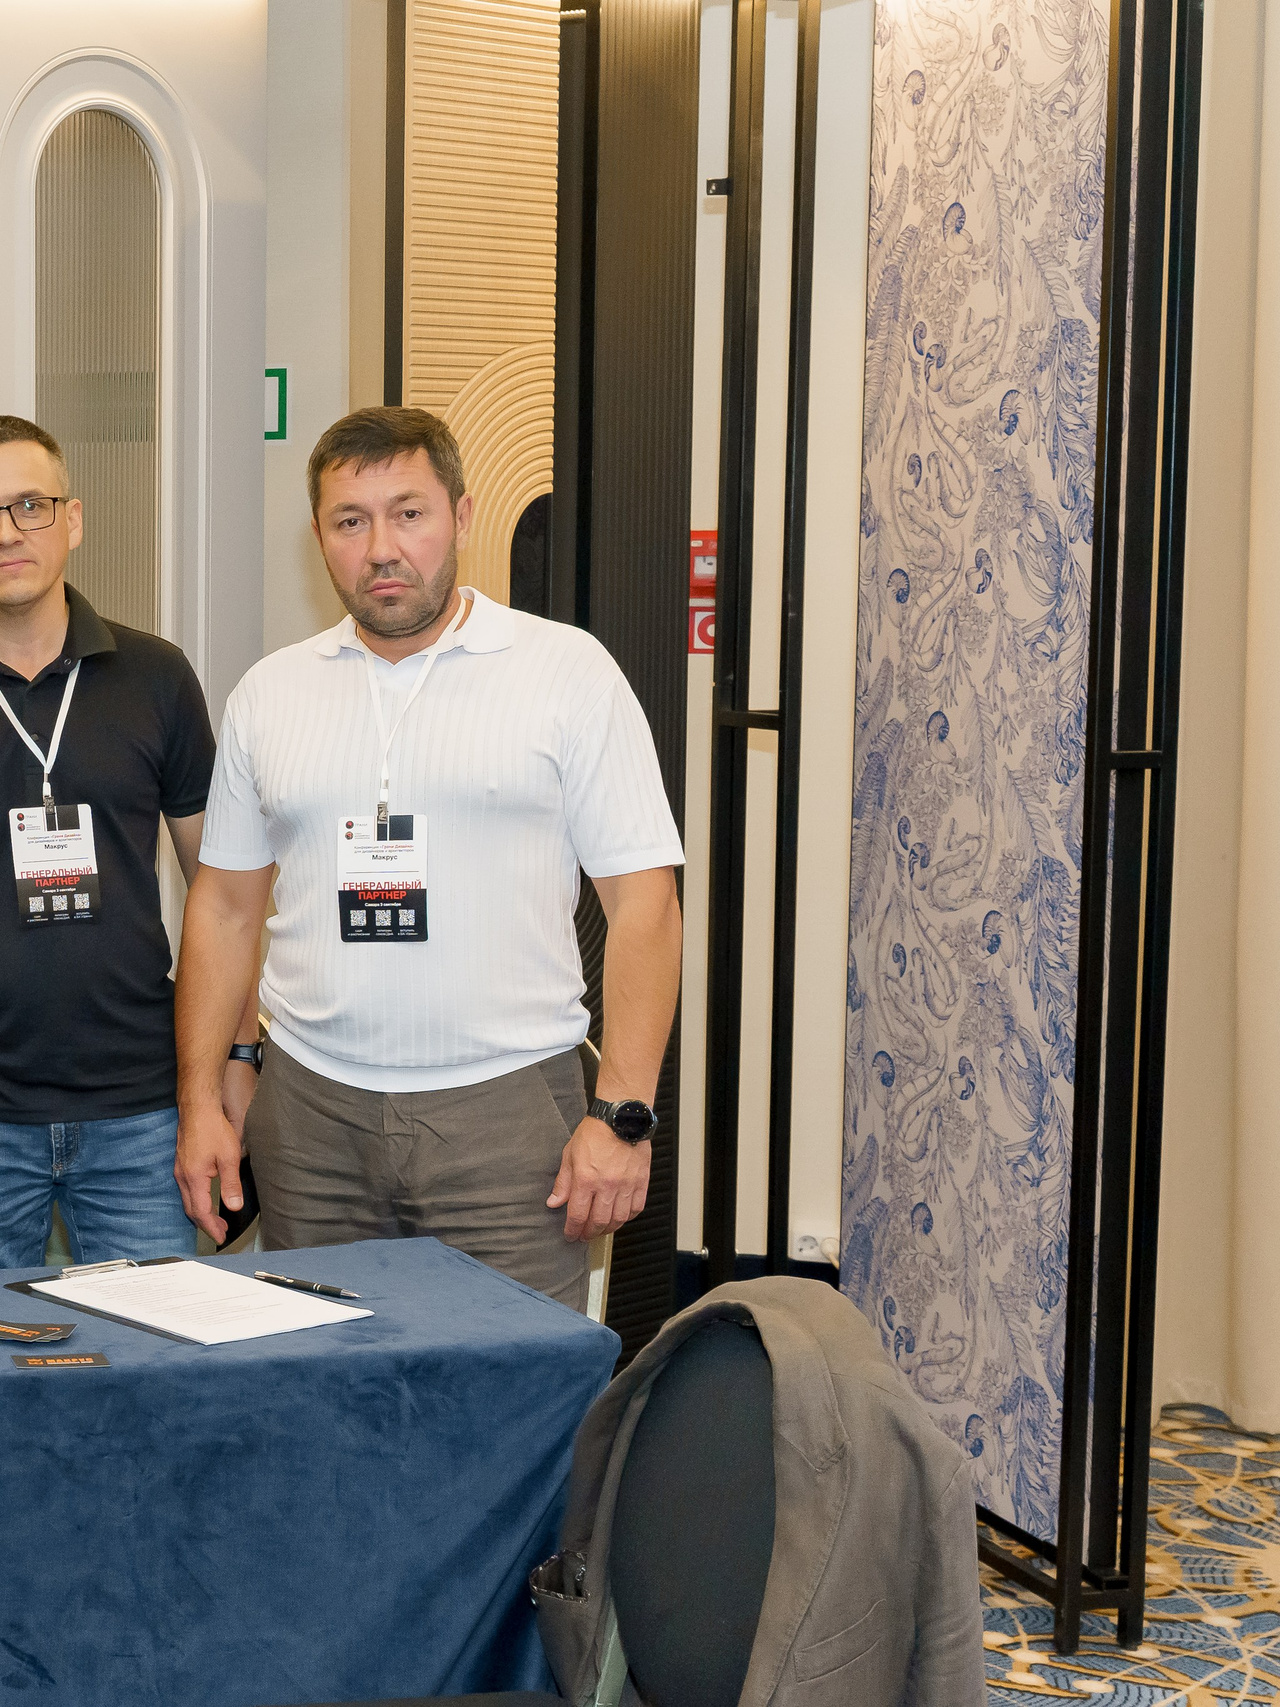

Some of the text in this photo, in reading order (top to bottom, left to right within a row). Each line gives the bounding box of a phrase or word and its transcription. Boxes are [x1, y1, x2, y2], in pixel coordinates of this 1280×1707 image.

[20, 865, 93, 879] ГЕНЕРАЛЬНЫЙ
[35, 876, 81, 887] ПАРТНЕР
[342, 879, 422, 891] ГЕНЕРАЛЬНЫЙ
[358, 891, 407, 900] ПАРТНЕР
